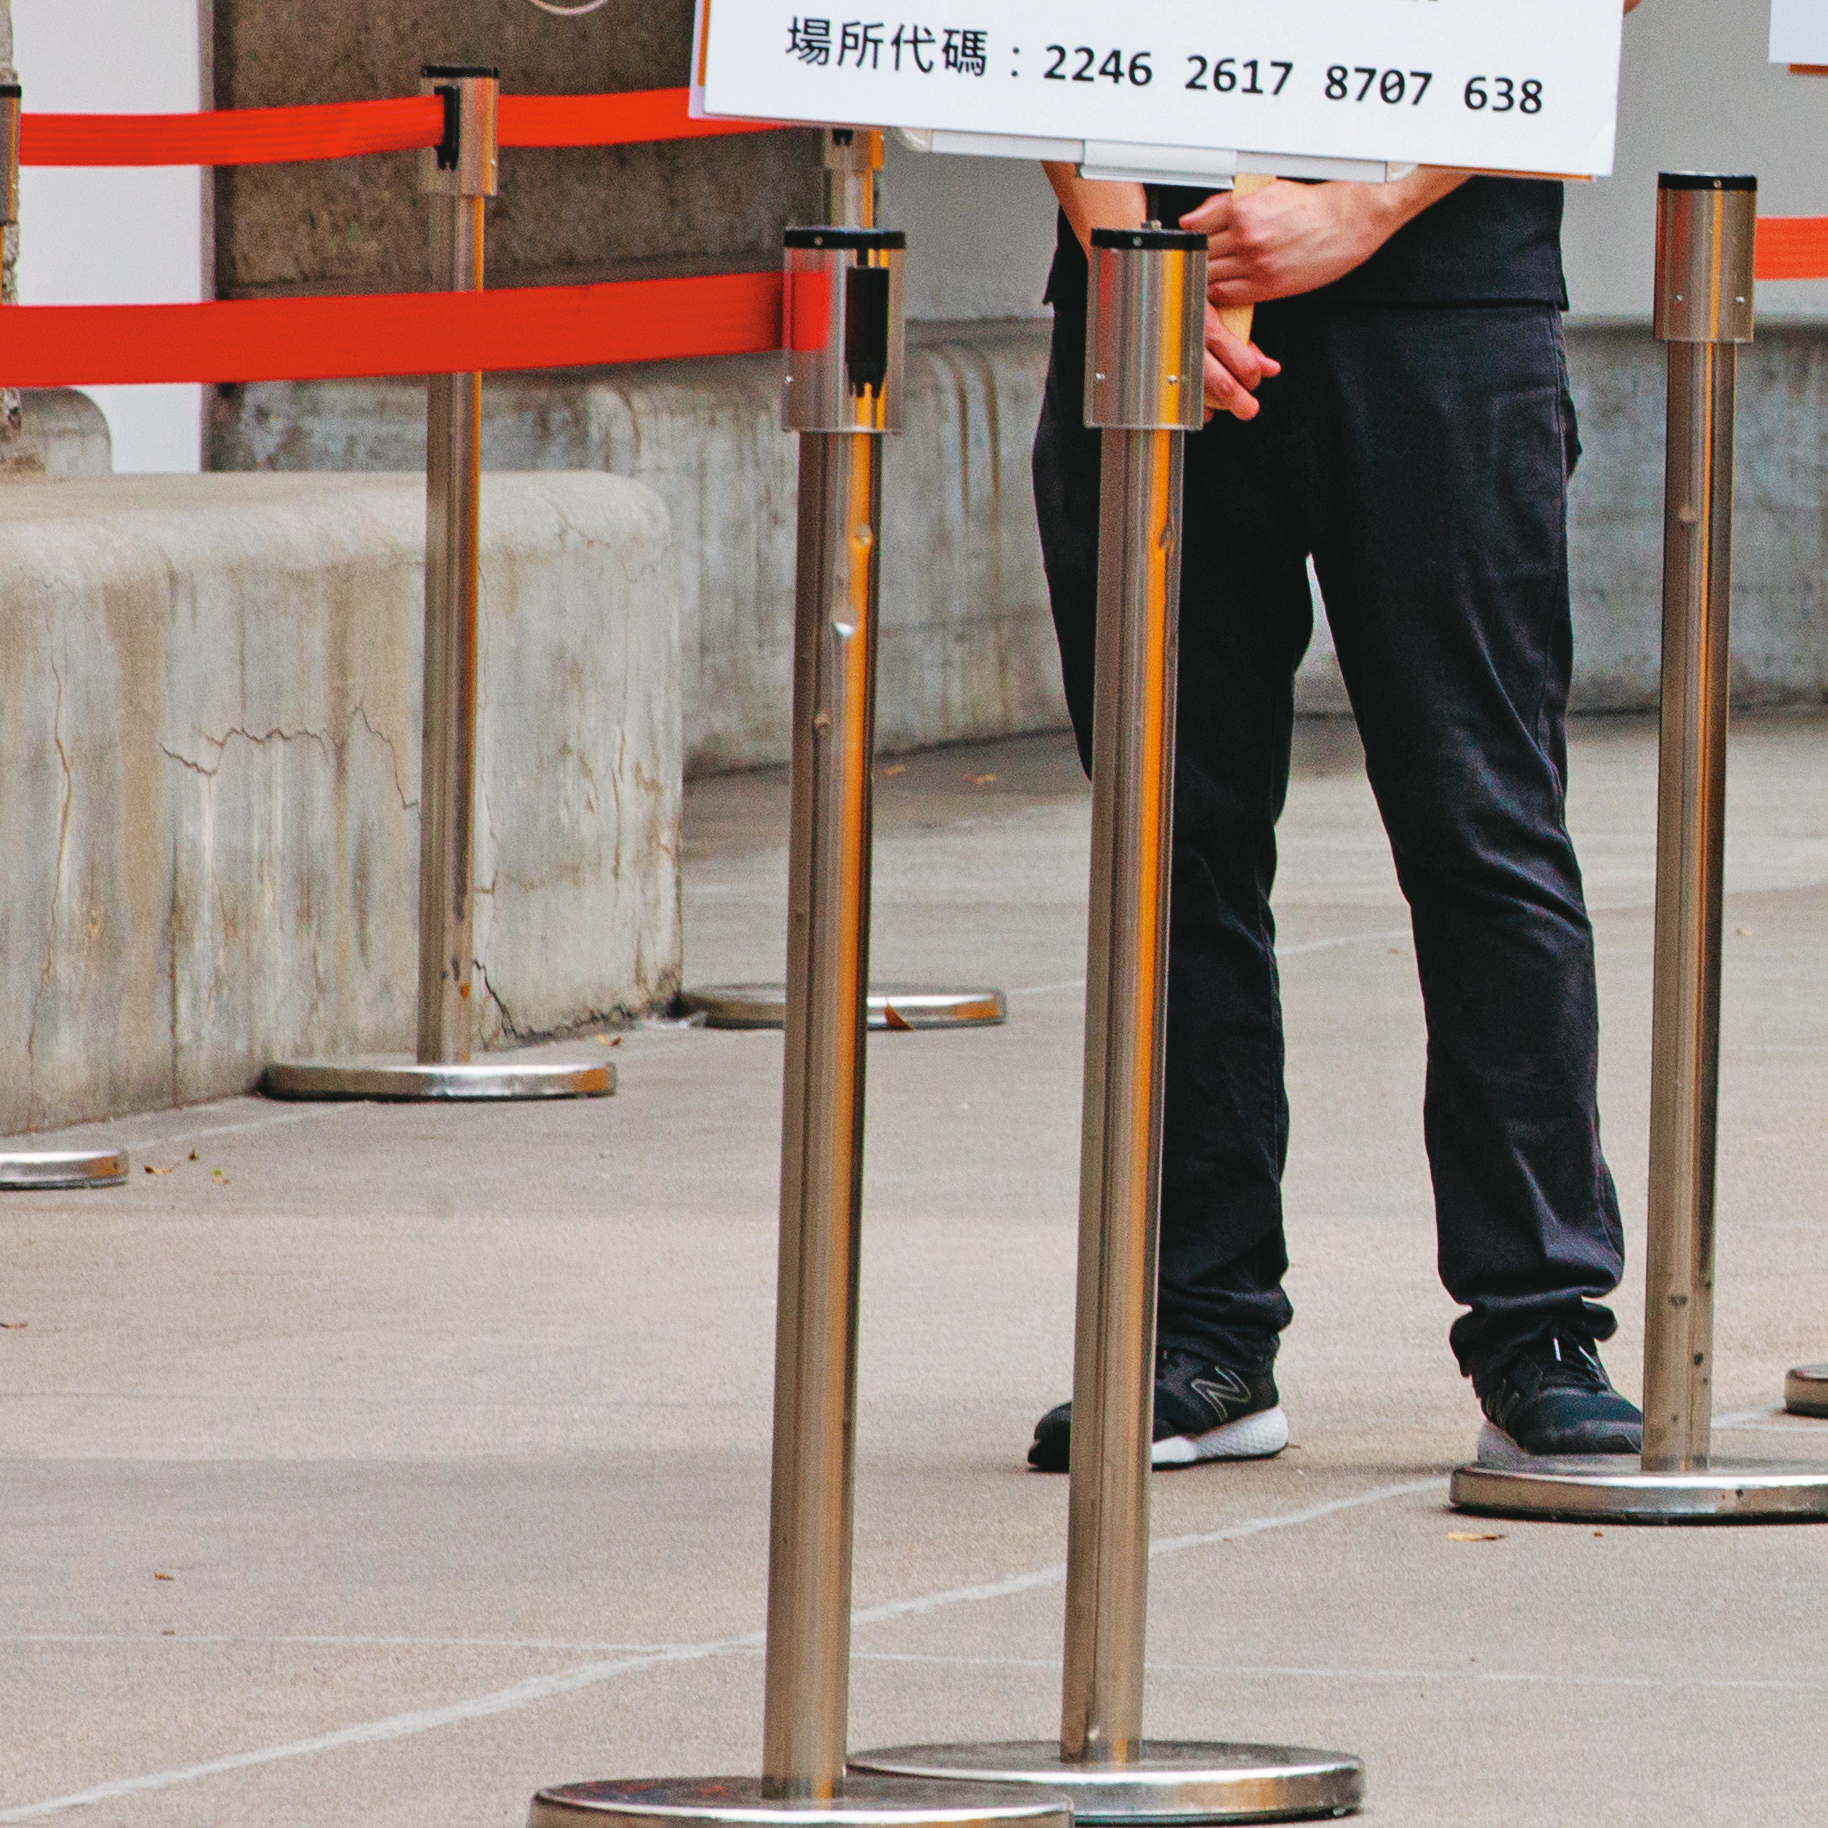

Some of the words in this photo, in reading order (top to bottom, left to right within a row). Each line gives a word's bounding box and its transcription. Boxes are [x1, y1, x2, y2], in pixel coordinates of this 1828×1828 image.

[1183, 53, 1295, 97] 2617
[1323, 64, 1434, 107] 8707
[1463, 74, 1544, 116] 638
